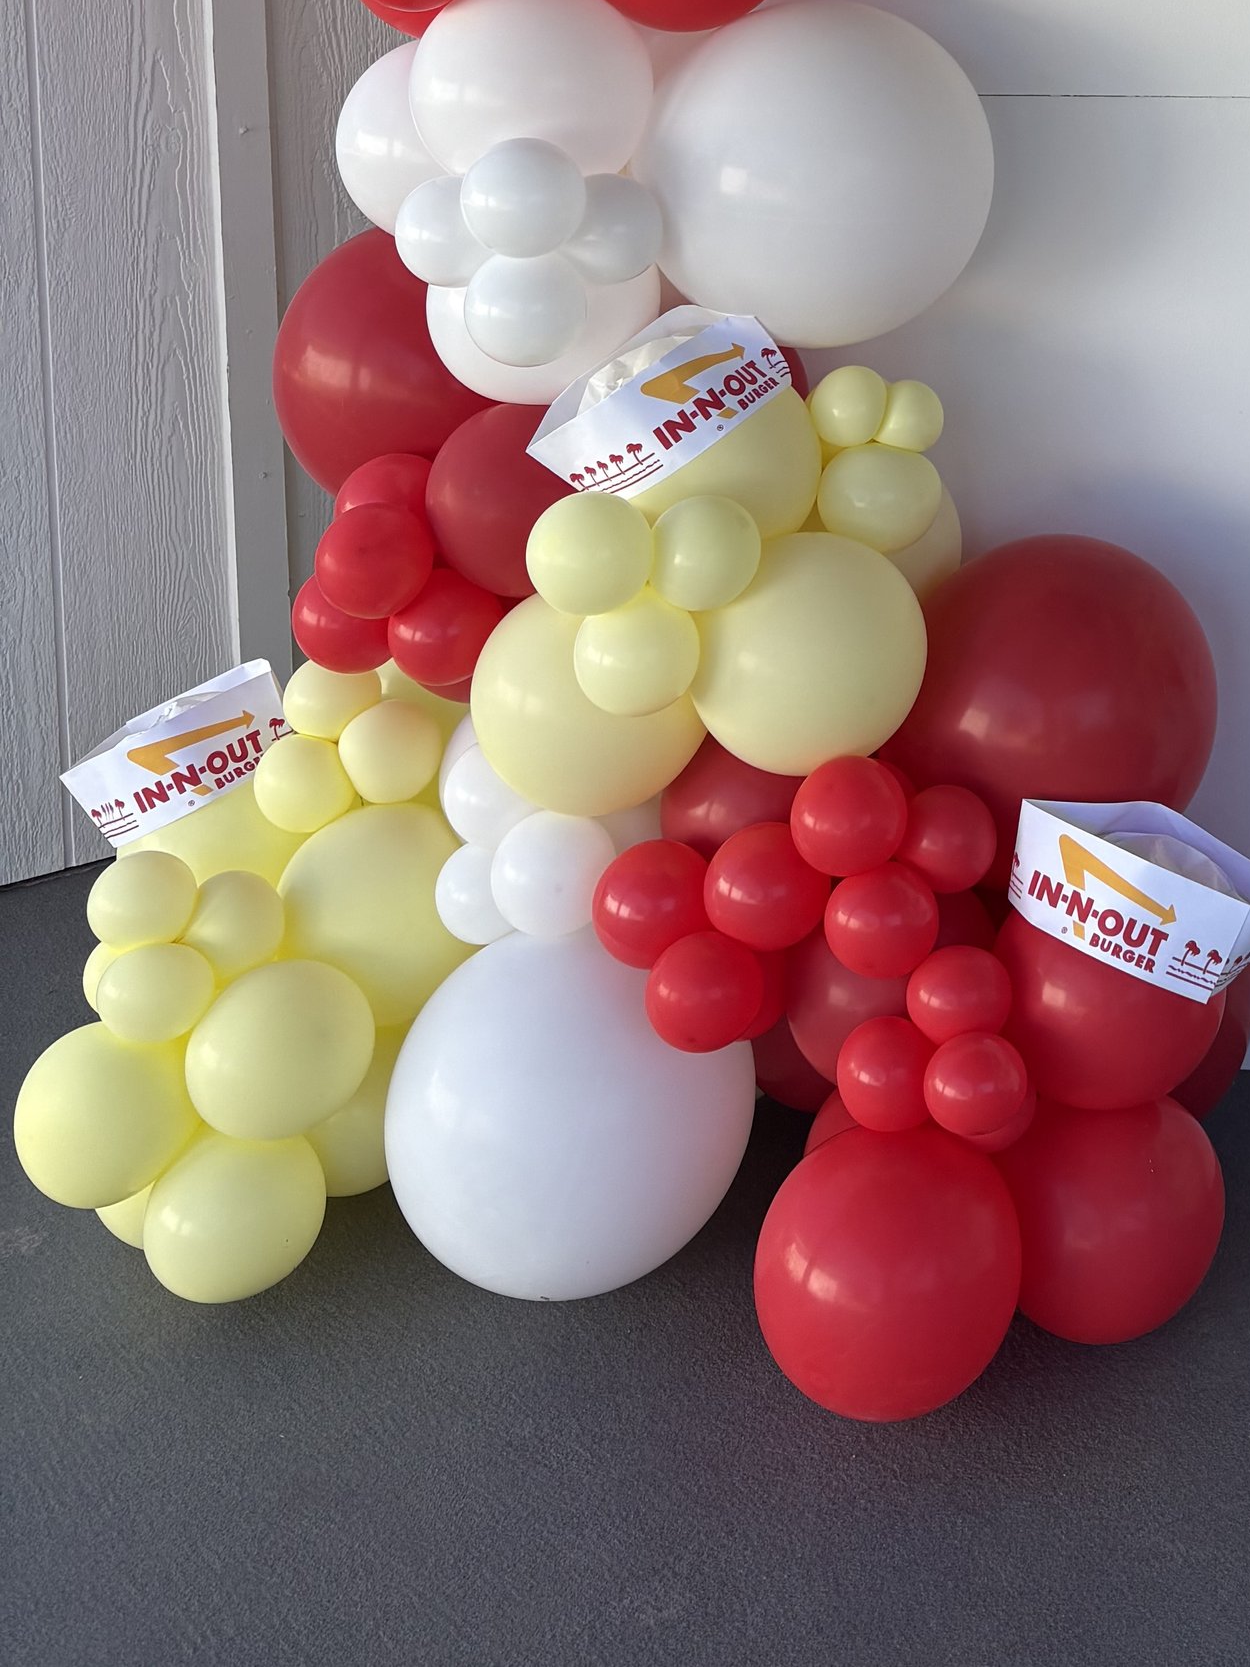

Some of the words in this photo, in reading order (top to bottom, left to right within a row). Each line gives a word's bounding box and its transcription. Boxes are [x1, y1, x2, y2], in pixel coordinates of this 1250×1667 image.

[652, 359, 768, 450] IN-N-OUT
[737, 376, 780, 411] BURGER
[133, 729, 263, 814] IN-N-OUT
[214, 754, 263, 790] BURG
[1027, 870, 1169, 957] IN-N-OUT
[1089, 932, 1156, 974] BURGER
